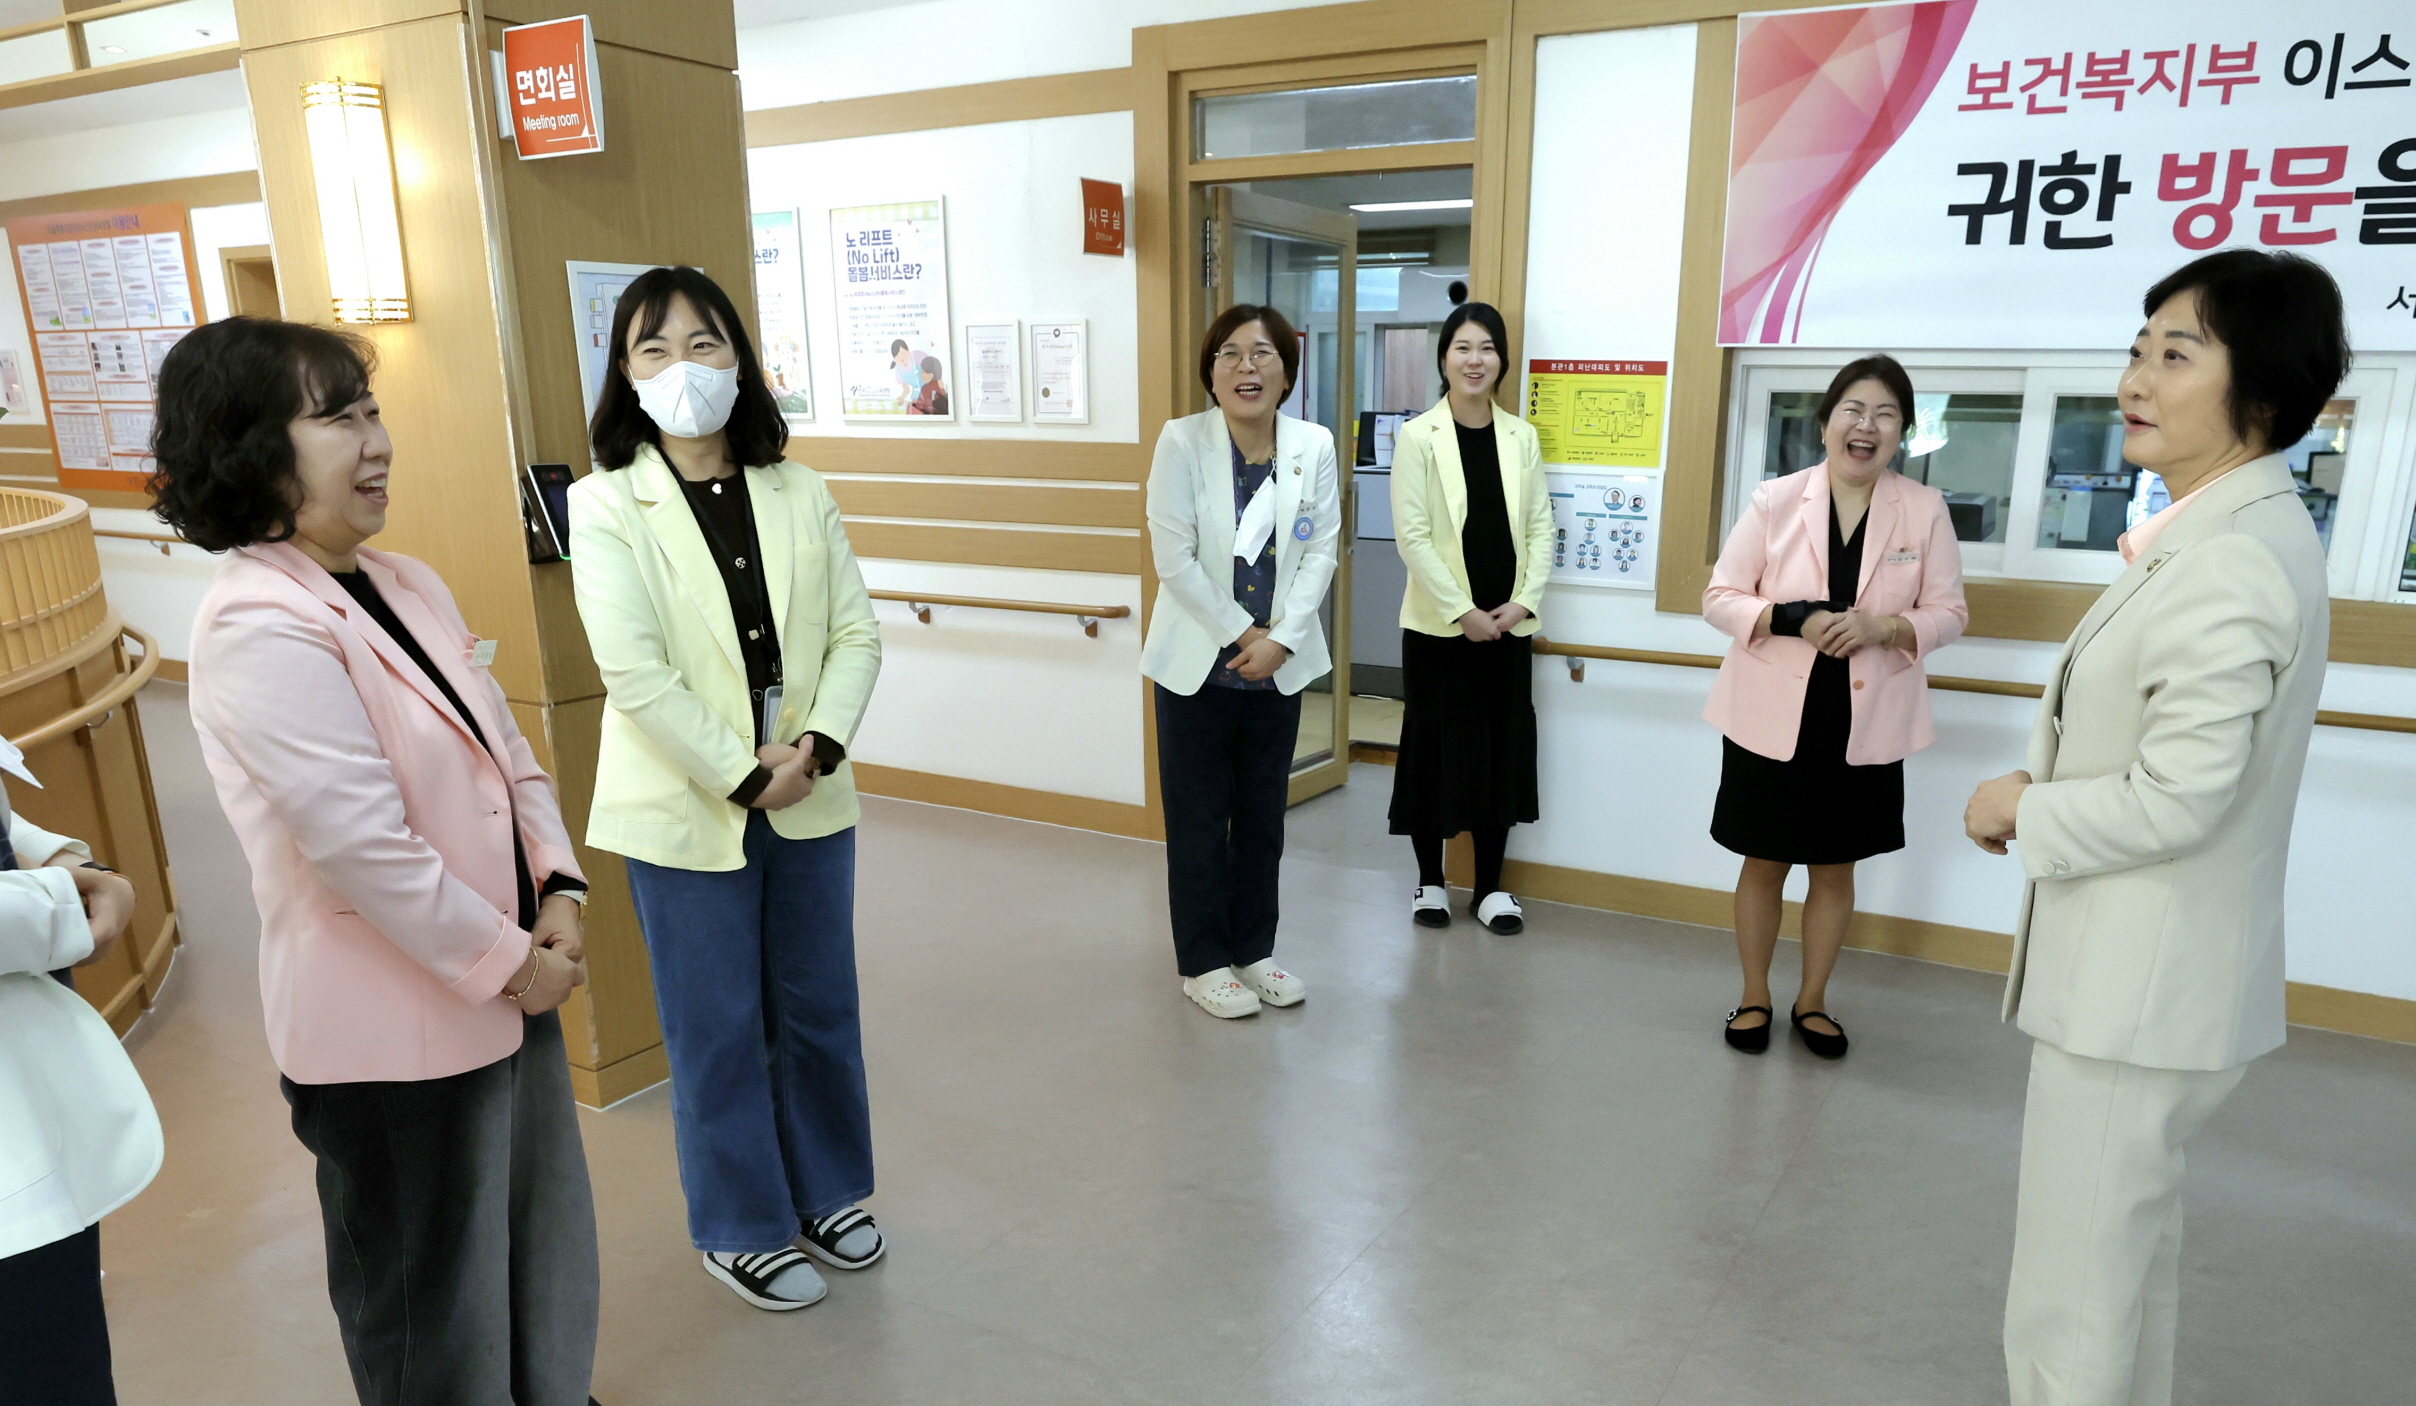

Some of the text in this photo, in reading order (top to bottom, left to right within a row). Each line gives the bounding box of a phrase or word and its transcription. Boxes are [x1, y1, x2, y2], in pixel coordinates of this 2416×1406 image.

[516, 63, 577, 106] 면회실
[1958, 32, 2411, 115] 보건복지부 이스
[522, 112, 580, 131] Meeting room
[1947, 136, 2416, 251] 귀한 방문을
[846, 229, 893, 248] 노 리프트
[847, 246, 900, 266] (No Lift)
